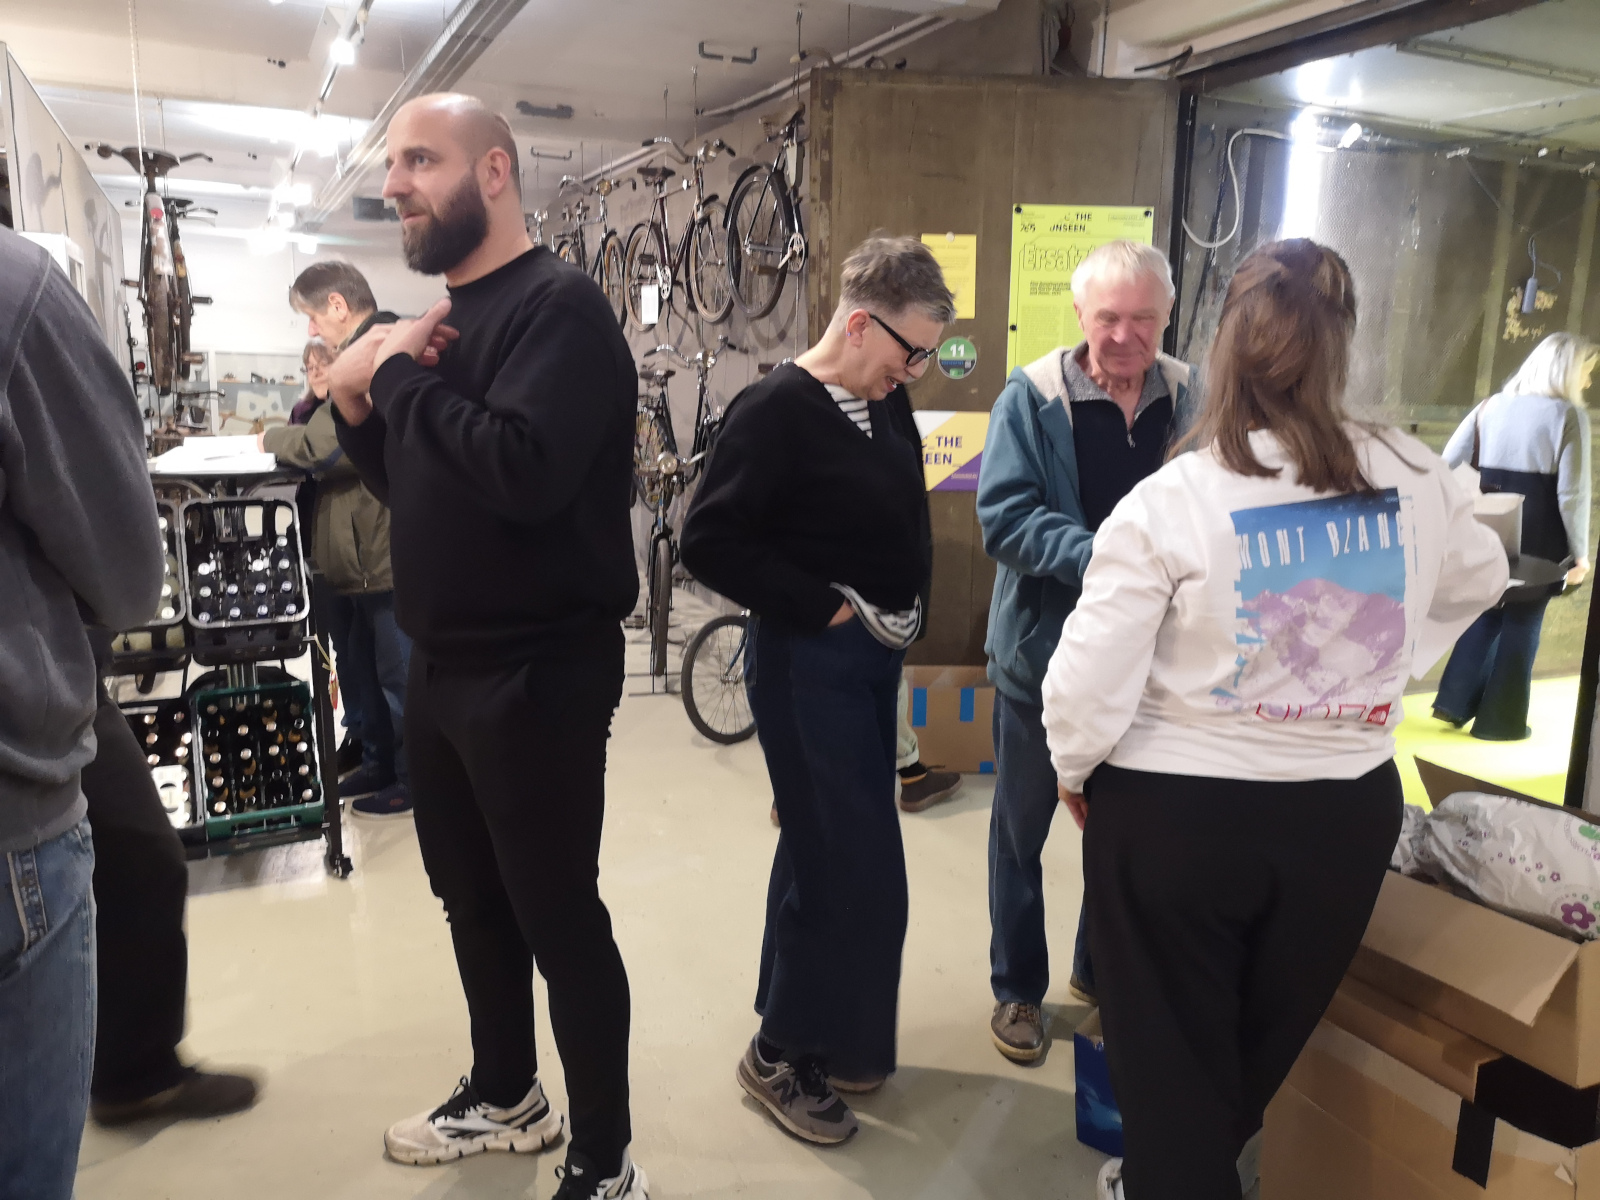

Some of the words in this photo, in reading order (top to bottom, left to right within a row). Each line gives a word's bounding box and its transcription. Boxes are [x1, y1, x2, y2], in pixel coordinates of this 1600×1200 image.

[1076, 213, 1092, 221] THE
[1022, 242, 1096, 272] Ersatz
[950, 344, 965, 358] 11
[1235, 526, 1305, 570] MONT
